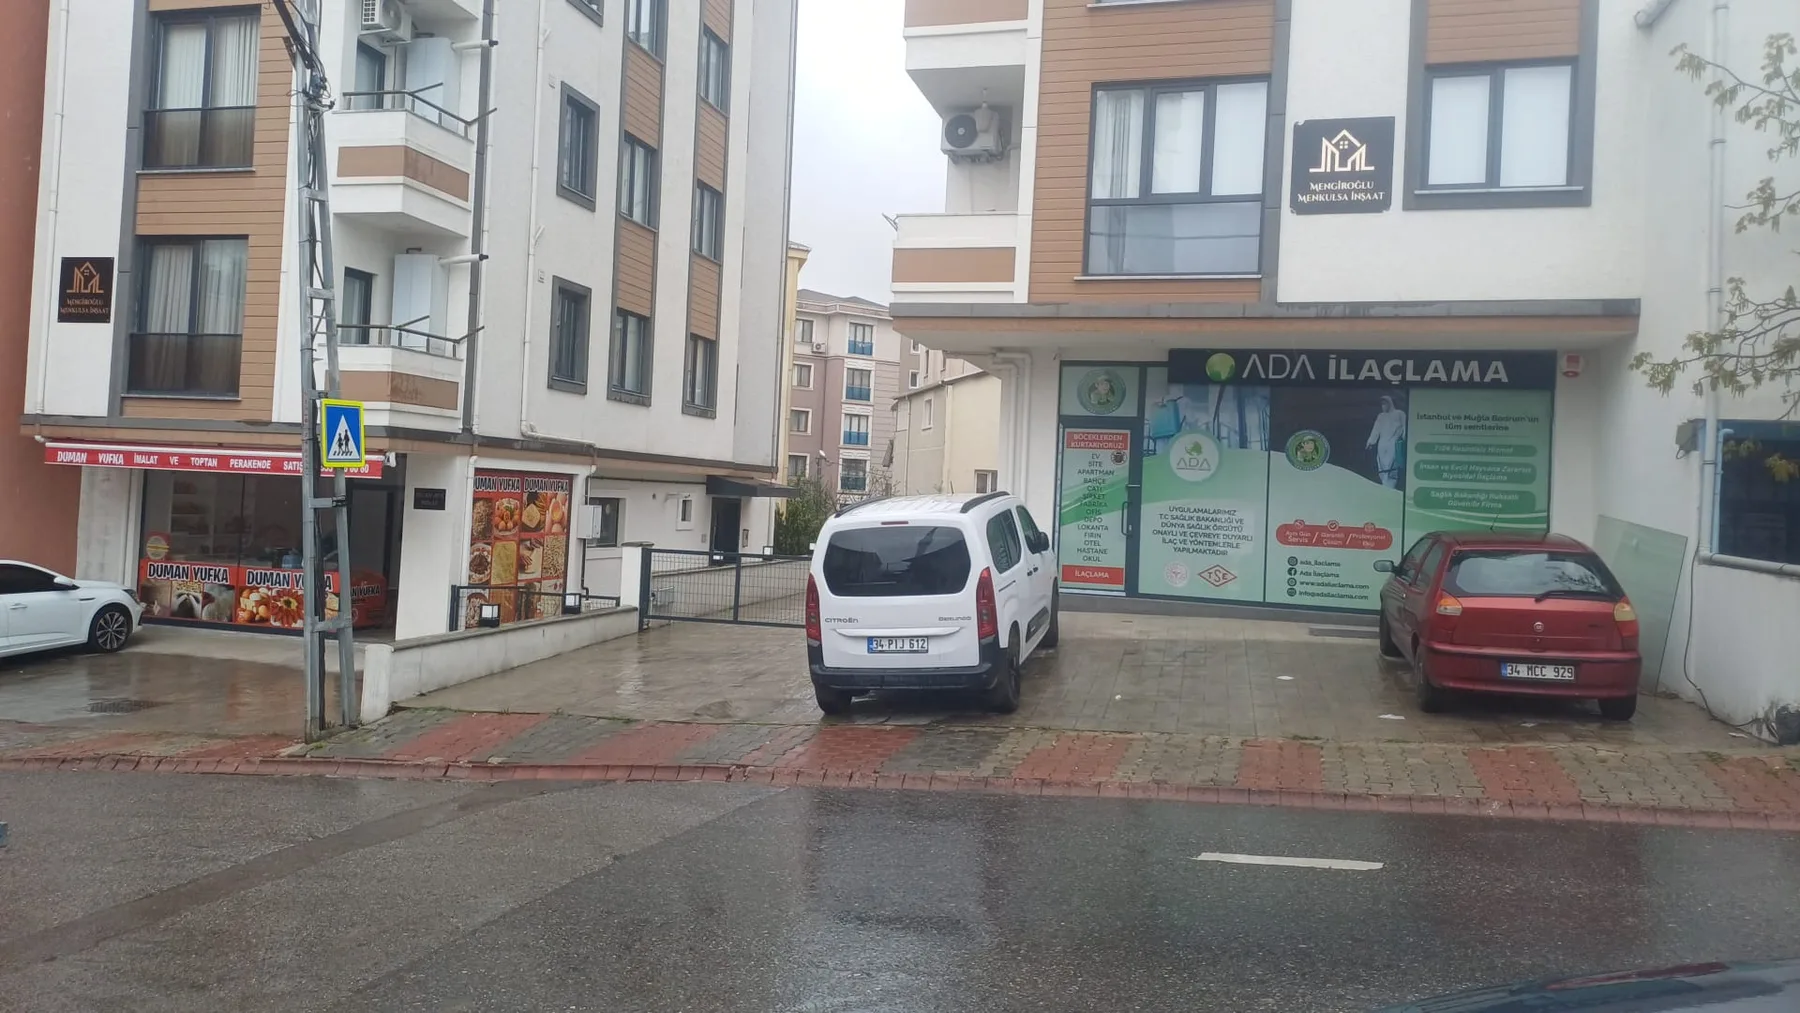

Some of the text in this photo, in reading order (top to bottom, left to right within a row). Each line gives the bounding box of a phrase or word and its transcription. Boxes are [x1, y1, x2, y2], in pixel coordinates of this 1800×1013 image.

[1309, 180, 1374, 192] MENGİROĞLU
[1297, 191, 1385, 203] MENKULSA İNŞAAT
[1242, 354, 1509, 384] ADA İLAÇLAMA
[1463, 414, 1490, 423] Muğla
[1445, 423, 1462, 431] tüm
[57, 451, 88, 464] DUMAN
[98, 452, 124, 465] YUFKA
[133, 452, 159, 465] İMALAT
[169, 456, 179, 466] VE
[190, 457, 218, 468] TOPTAN
[229, 458, 272, 470] PERAKENDE
[1176, 457, 1211, 468] ADA
[1077, 468, 1115, 476] APARTMAN
[499, 477, 521, 493] YUFKA
[523, 477, 569, 494] DUMAN YUFKA
[1169, 505, 1237, 516] UYGULAMALARIMIZ
[1170, 513, 1195, 521] SAĞLIK
[1196, 515, 1234, 524] BAKANLIĞI
[1161, 521, 1243, 533] DÜNYA SAĞLIK ÖRGÜTÜ
[1152, 529, 1177, 537] ONAYLI
[1189, 531, 1222, 540] ÇEVREYE
[1222, 533, 1253, 541] DUYARLI
[1161, 537, 1177, 546] İLAÇ
[1189, 539, 1241, 549] YÖNTEMLERLE
[1076, 547, 1109, 555] HASTANE
[147, 562, 229, 585] DUMAN YUFKA
[246, 569, 291, 588] DUMAN
[1075, 568, 1110, 578] İLAÇLAMA
[1207, 568, 1229, 583] TSE
[873, 639, 884, 650] 34
[909, 639, 926, 650] 612
[1507, 664, 1573, 679] 34 MCC 929
